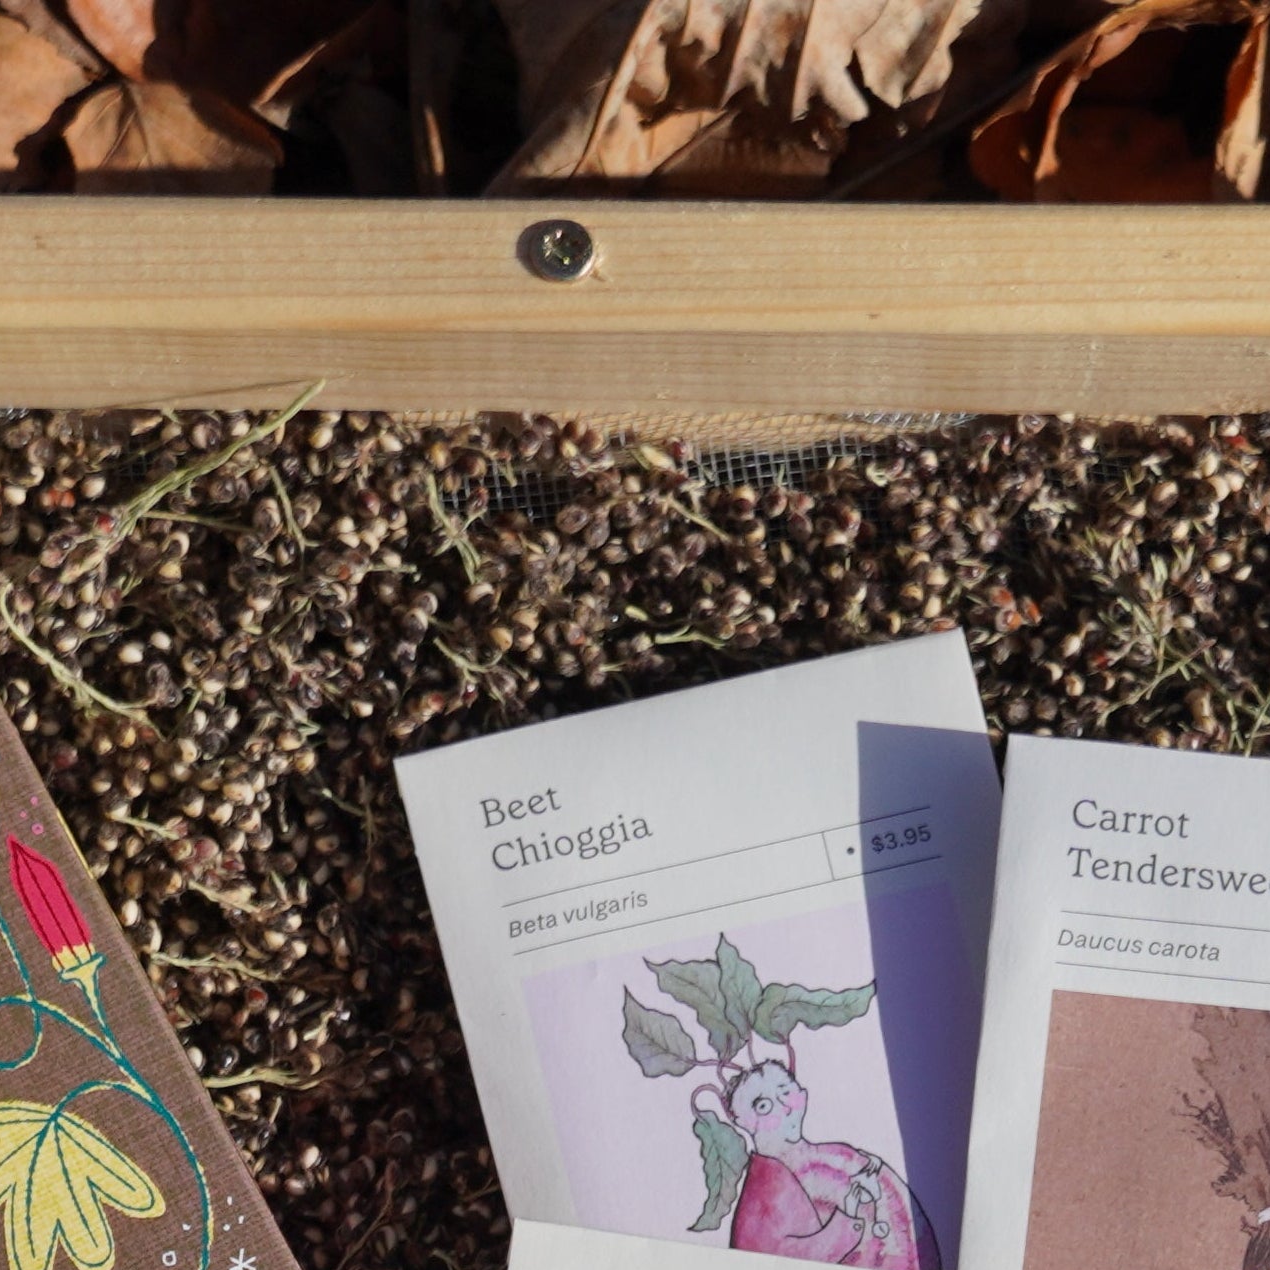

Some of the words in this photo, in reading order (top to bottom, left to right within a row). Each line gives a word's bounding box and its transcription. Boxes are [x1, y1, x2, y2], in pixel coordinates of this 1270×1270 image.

[479, 787, 562, 829] Beet
[1072, 799, 1190, 839] Carrot
[491, 814, 653, 872] Chioggia
[870, 822, 932, 855] $3.95
[509, 913, 559, 939] Beta
[562, 890, 648, 925] vulgaris
[1057, 928, 1143, 954] Daucus
[1147, 941, 1220, 962] carota
